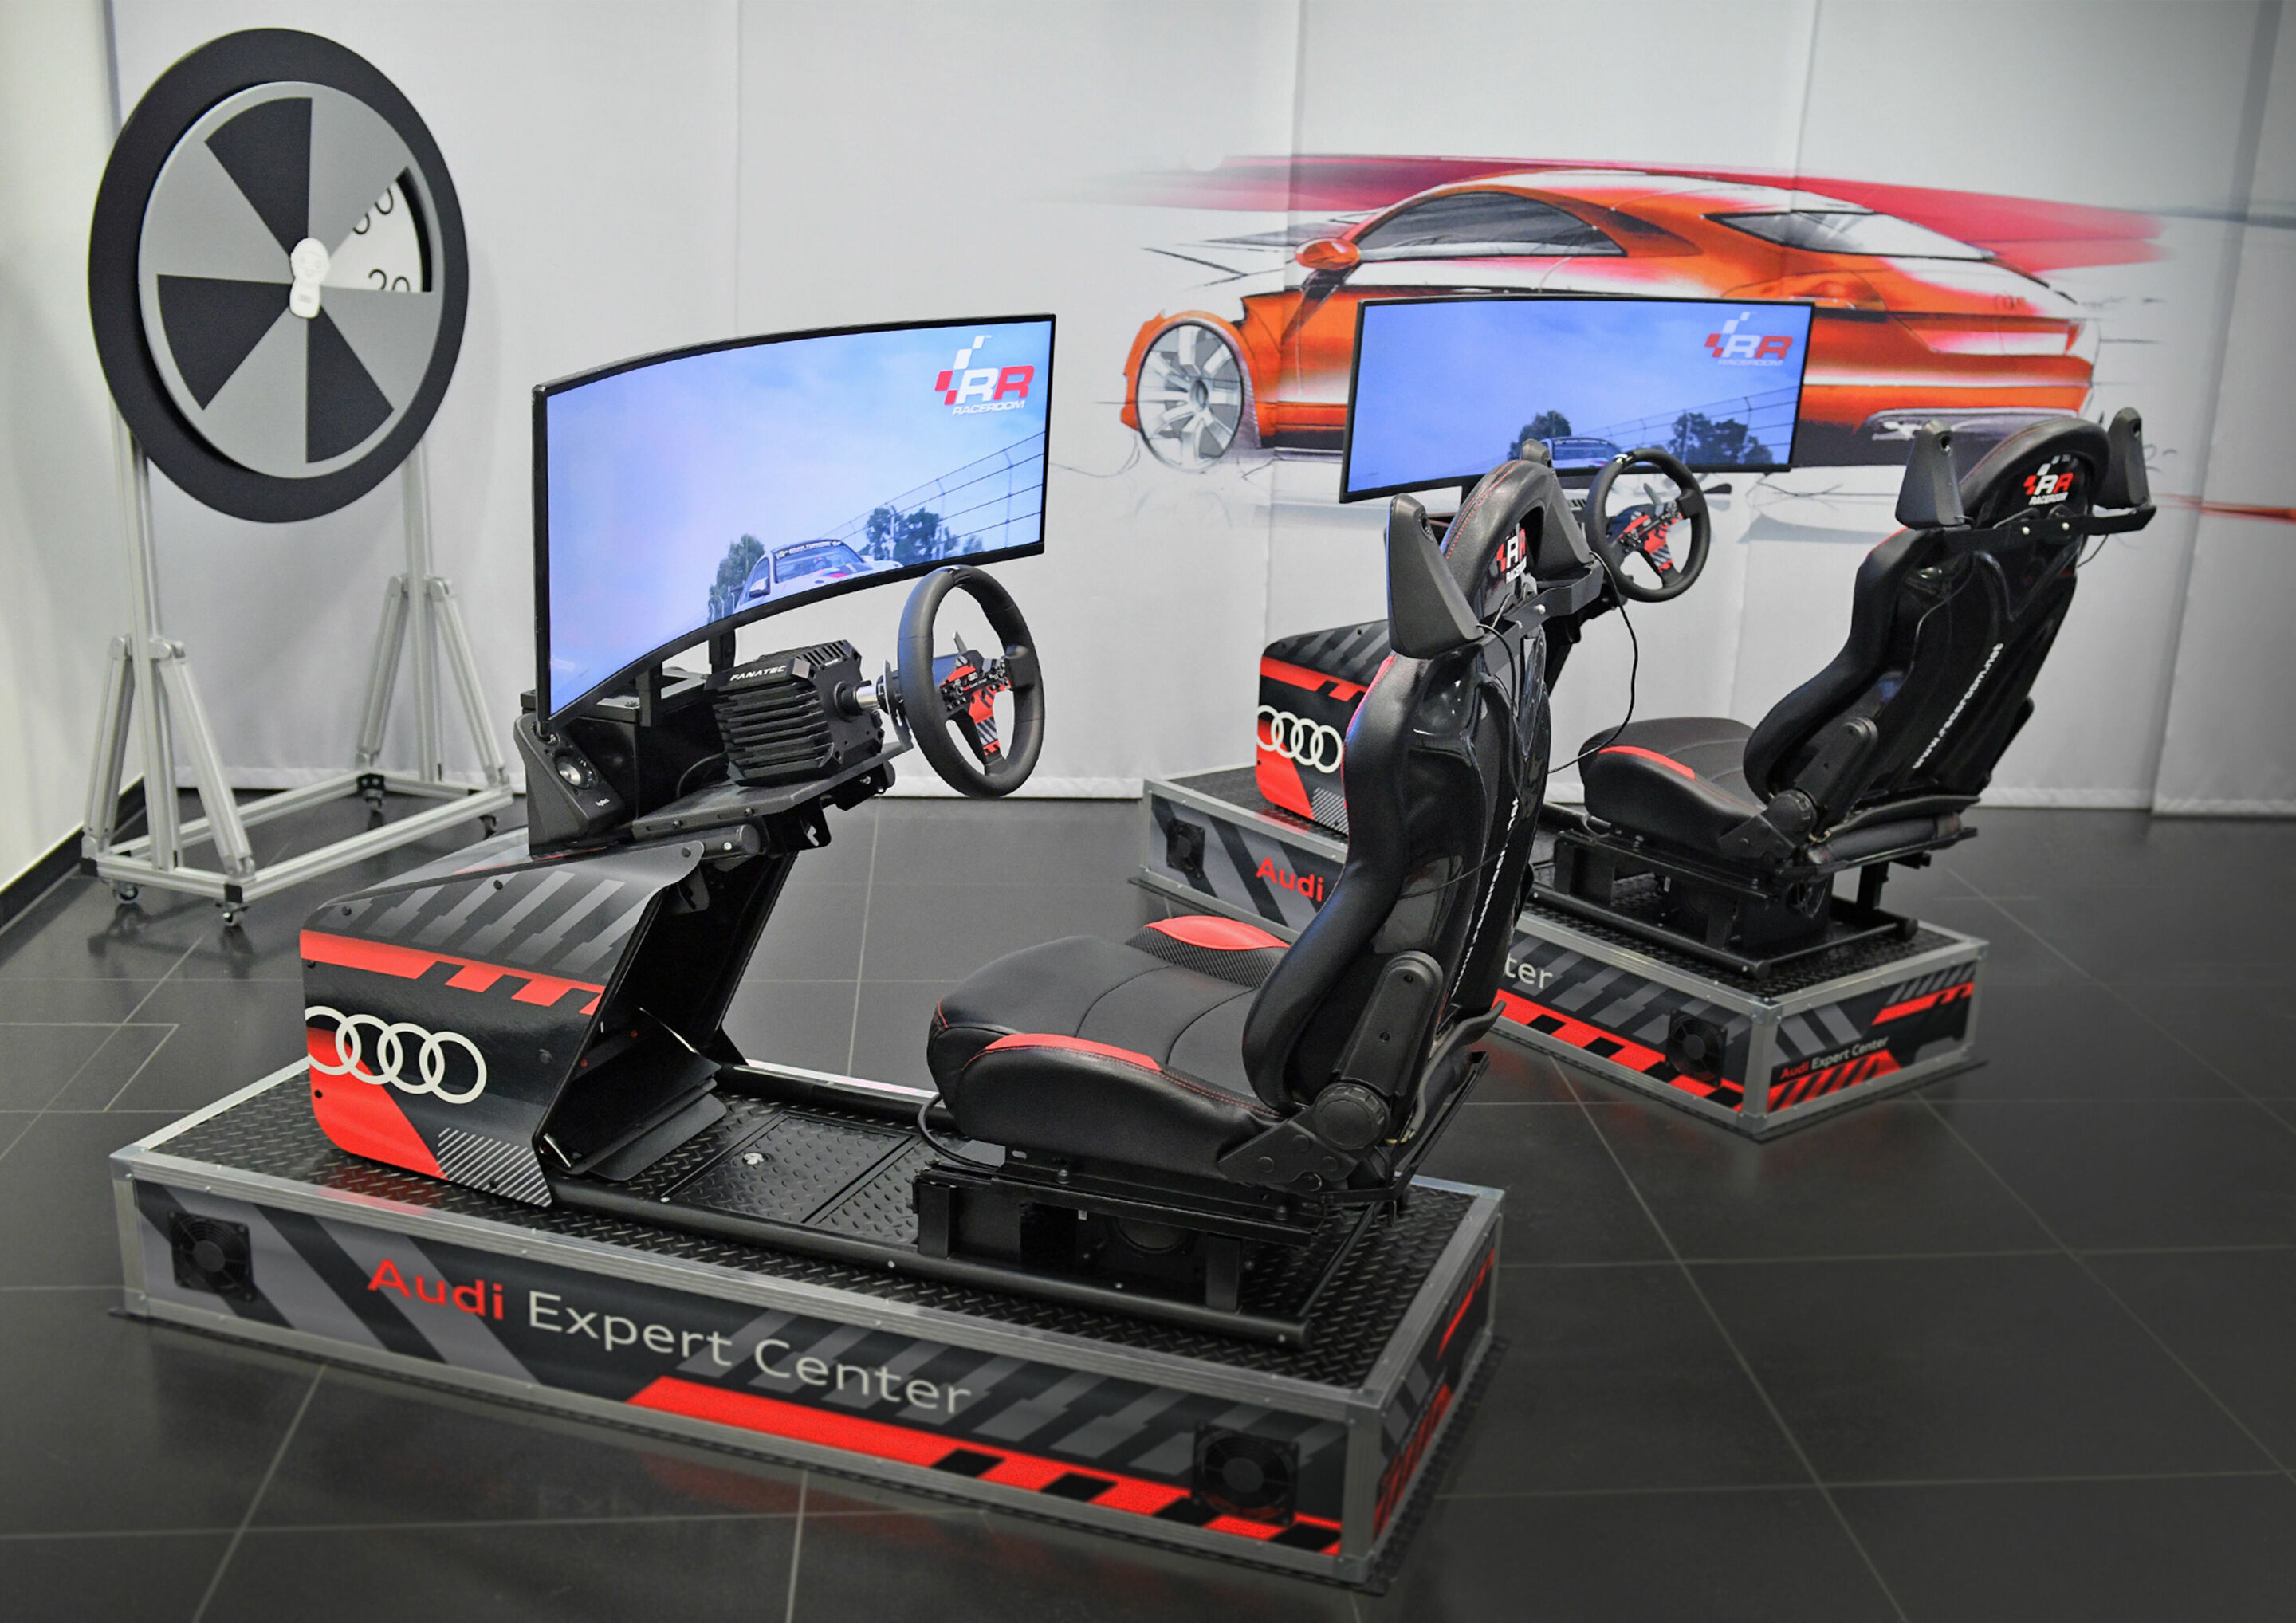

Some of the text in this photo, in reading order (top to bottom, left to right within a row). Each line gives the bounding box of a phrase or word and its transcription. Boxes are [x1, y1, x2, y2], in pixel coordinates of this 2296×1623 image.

[1723, 335, 1794, 359] RR
[955, 365, 1035, 404] RR
[952, 400, 1026, 415] RACEROOM
[729, 665, 787, 682] FANATEC
[1256, 856, 1324, 902] Audi
[1504, 952, 1554, 989] ter
[1781, 1037, 1889, 1078] Audi Expert Center
[367, 1259, 973, 1413] Audi Expert Center
